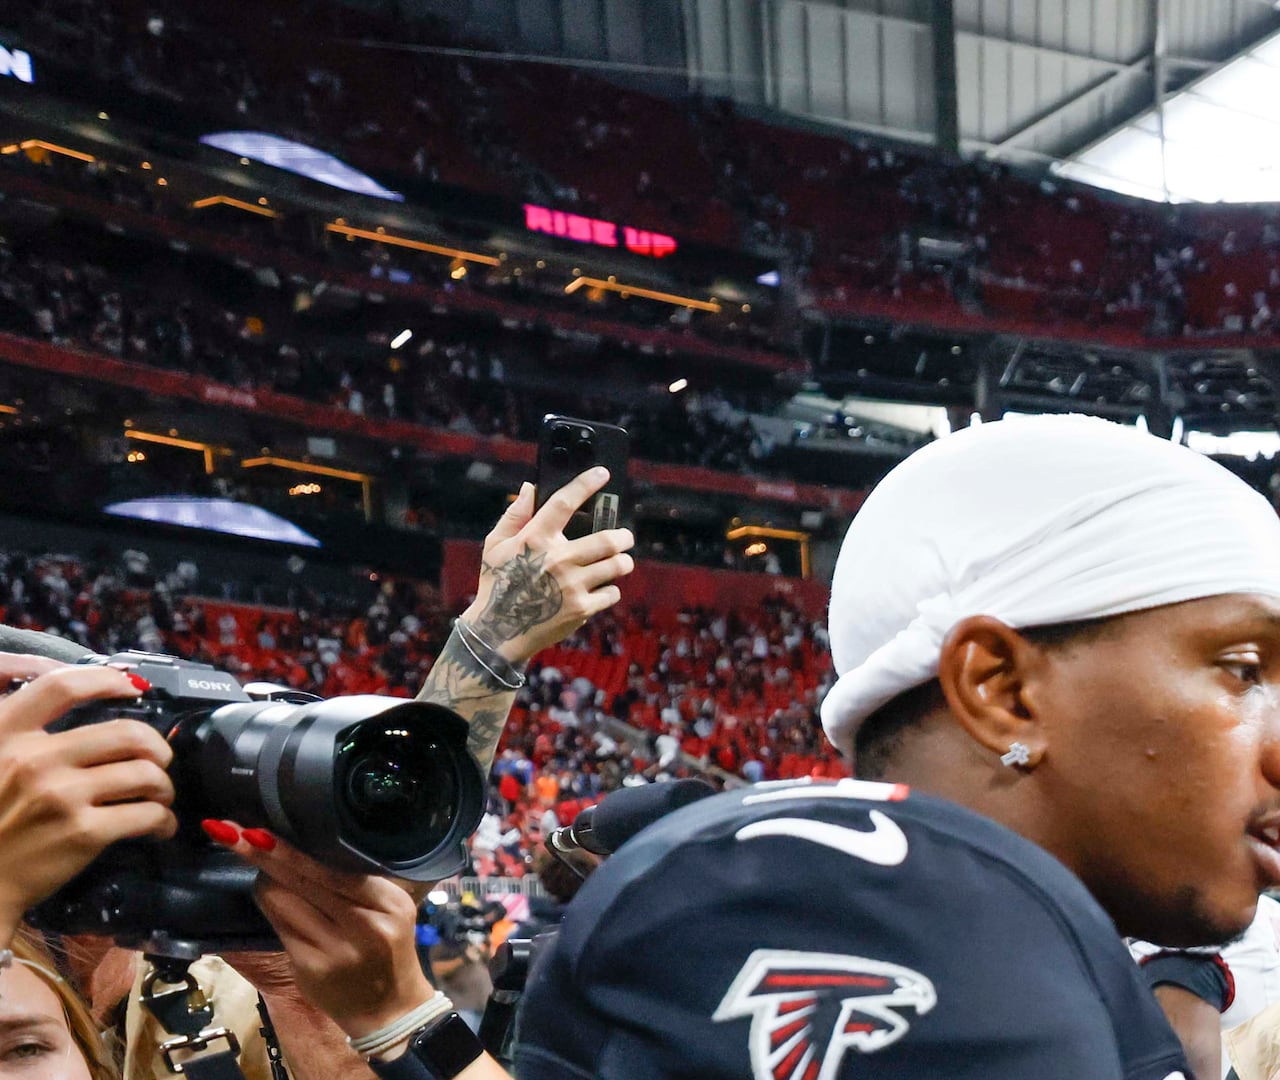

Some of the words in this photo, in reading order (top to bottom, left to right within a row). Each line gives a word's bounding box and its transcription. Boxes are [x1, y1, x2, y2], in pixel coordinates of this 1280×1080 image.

[523, 203, 618, 248] RISE
[624, 226, 678, 259] UP
[188, 679, 232, 692] SONY
